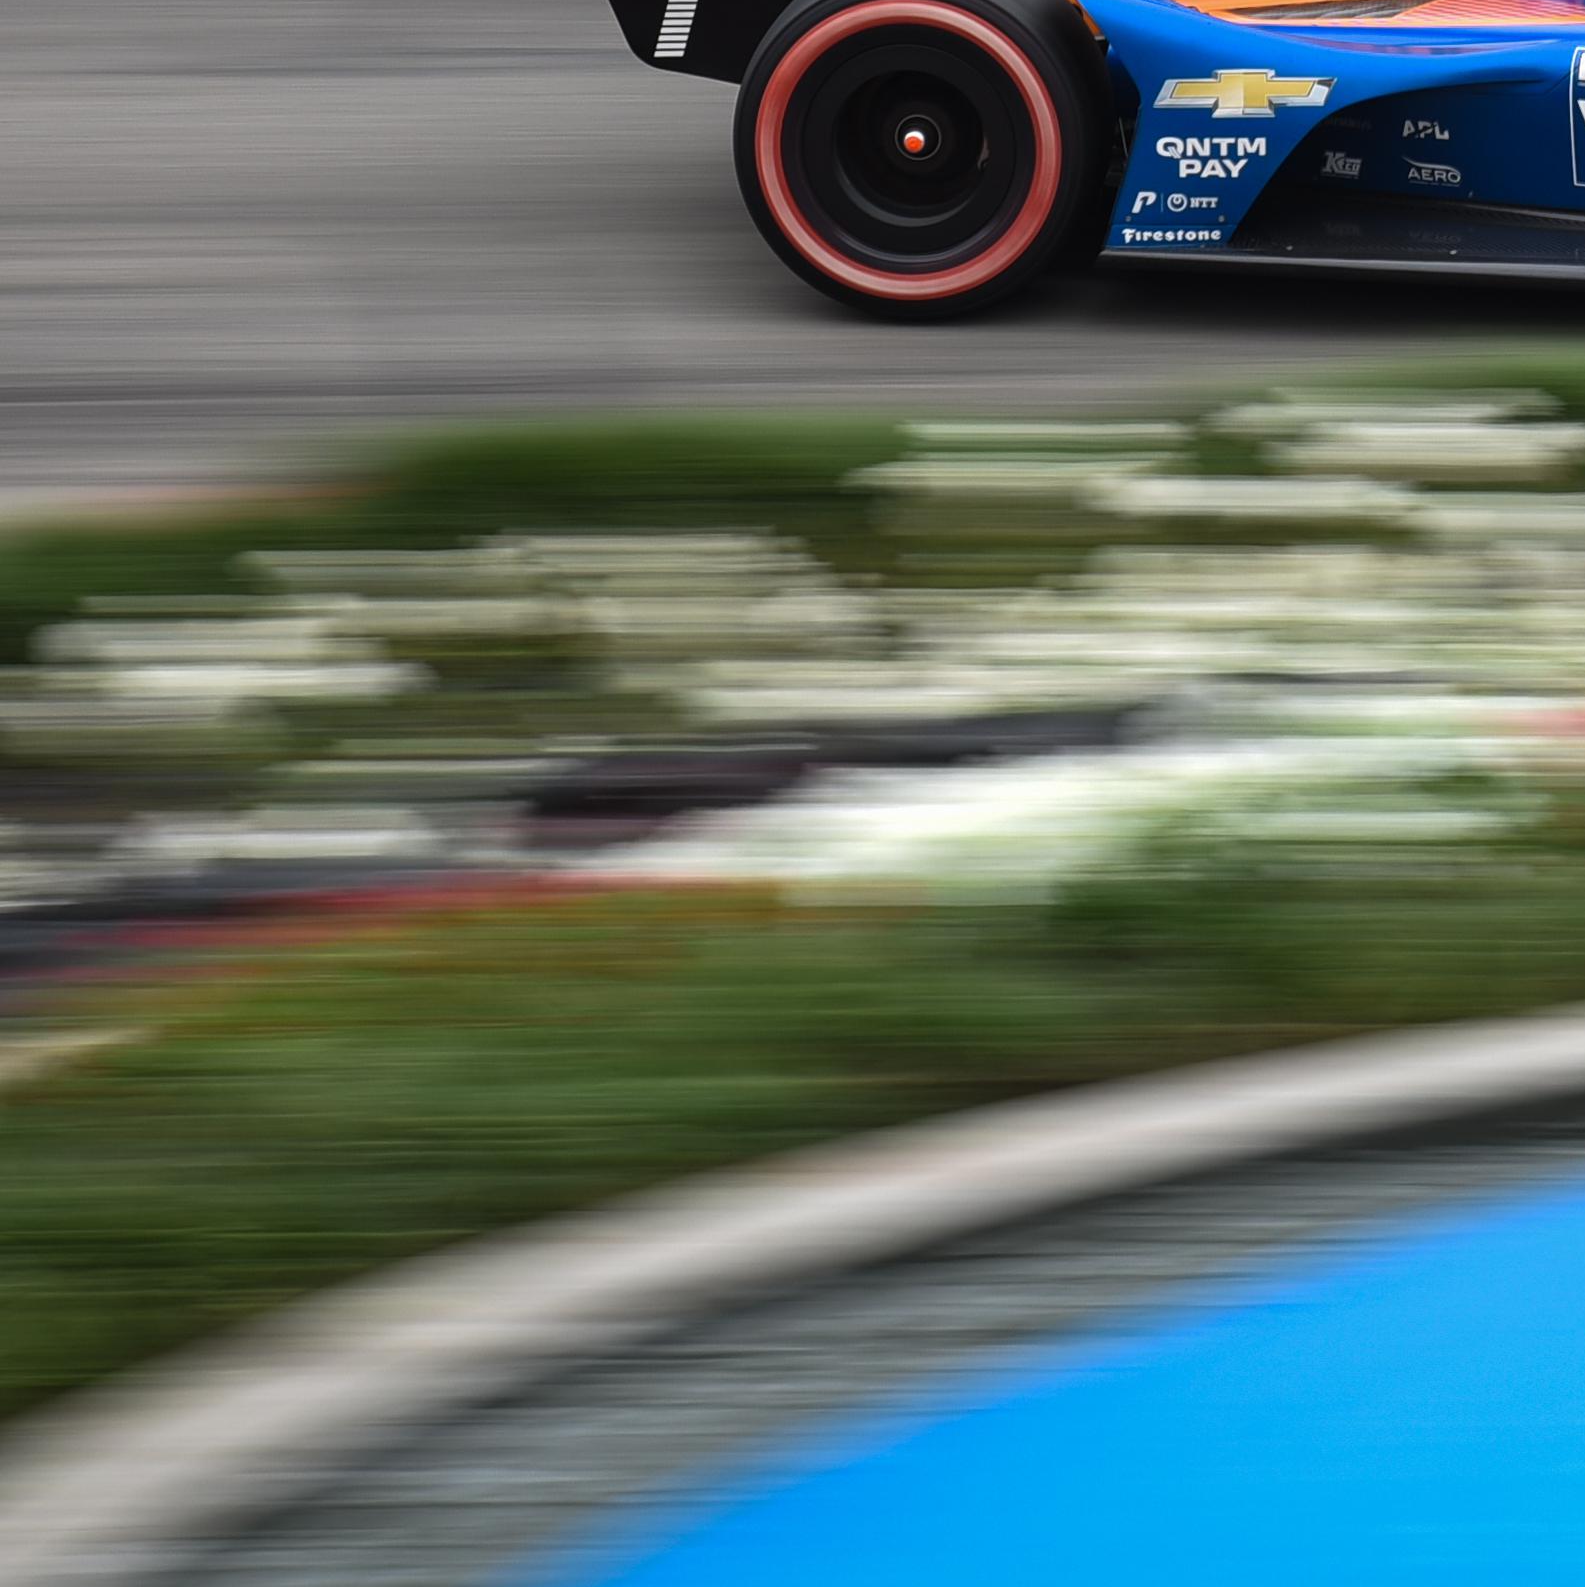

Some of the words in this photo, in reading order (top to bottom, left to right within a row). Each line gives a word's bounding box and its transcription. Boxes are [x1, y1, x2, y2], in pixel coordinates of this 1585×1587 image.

[1156, 136, 1267, 159] QNTM
[1179, 159, 1248, 178] PAY
[1408, 167, 1461, 184] AERO
[1190, 197, 1218, 208] NTT
[1121, 228, 1222, 244] Firestone
